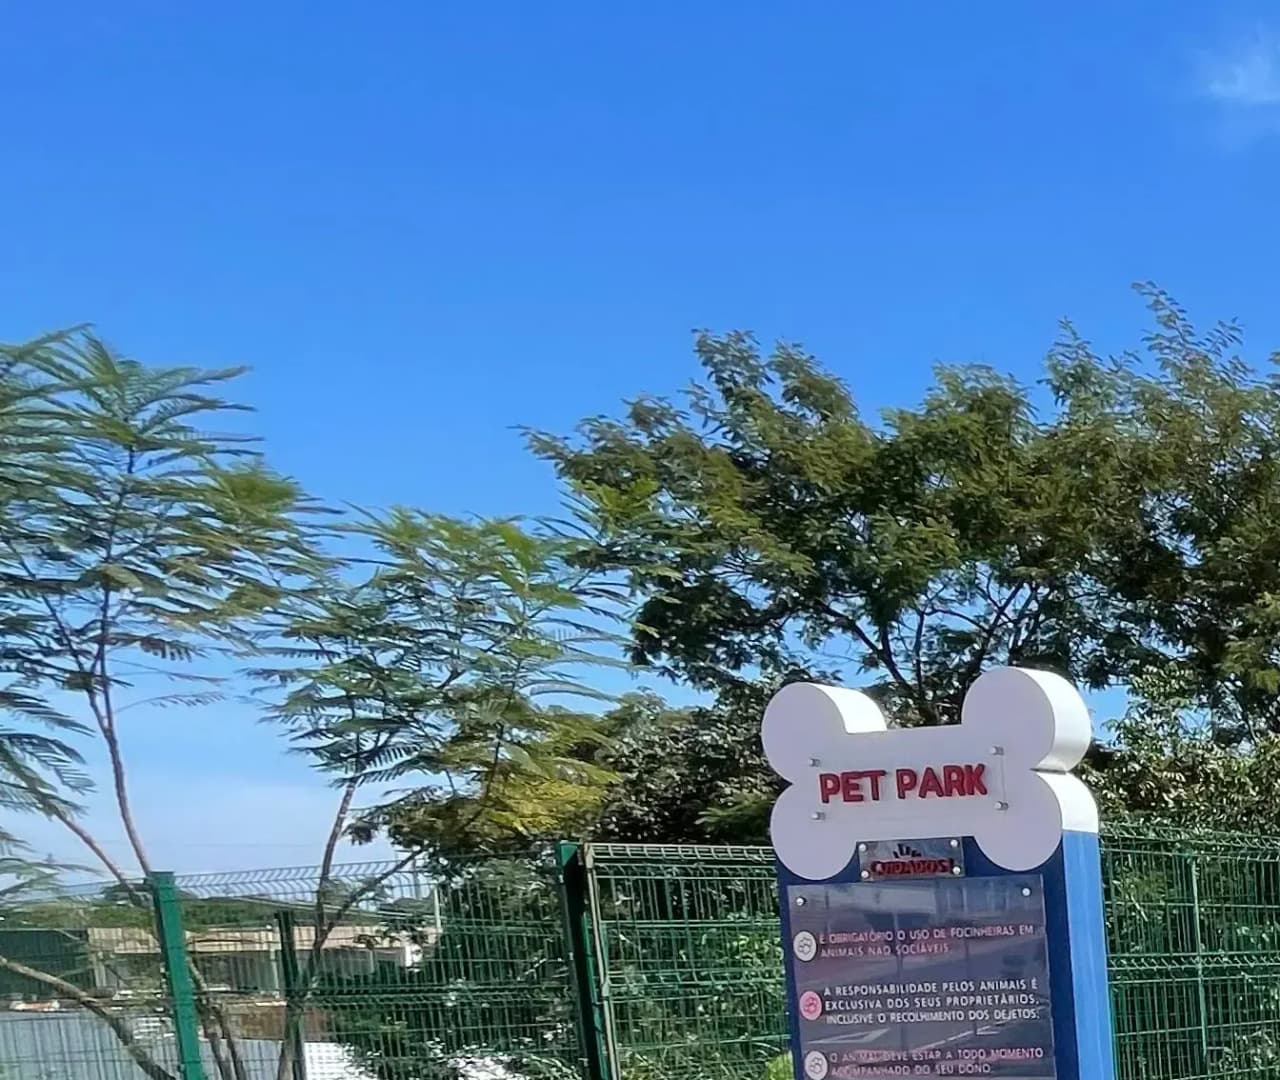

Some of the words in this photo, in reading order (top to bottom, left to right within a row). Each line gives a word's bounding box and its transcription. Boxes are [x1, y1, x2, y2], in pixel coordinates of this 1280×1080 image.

[819, 770, 887, 803] PET
[896, 763, 988, 799] PARK
[897, 930, 905, 940] O
[909, 929, 929, 940] USO
[933, 928, 946, 938] DE
[951, 925, 1014, 937] FOCINHEIRAS
[1019, 925, 1033, 935] EM
[821, 947, 864, 957] ANIMAIS
[824, 986, 831, 996] A
[835, 983, 937, 996] RESPONSABILIDADE
[942, 981, 975, 992] PELOS
[980, 979, 1026, 990] ANIMAIS
[1031, 977, 1038, 989] É
[825, 999, 882, 1011] EXCLUSIVA
[887, 998, 909, 1009] DOS
[914, 997, 940, 1007] SEUS
[826, 1013, 873, 1025] INCLUSIVE
[878, 1013, 886, 1023] O
[890, 1010, 964, 1023] RECOLHIMENTO
[968, 1009, 989, 1020] DOS
[912, 1049, 941, 1060] ESTAR
[945, 1050, 952, 1059] A
[958, 1048, 986, 1060] TODO
[991, 1048, 1043, 1060] MOMENTO
[914, 1064, 931, 1075] DO
[935, 1063, 954, 1075] SEU
